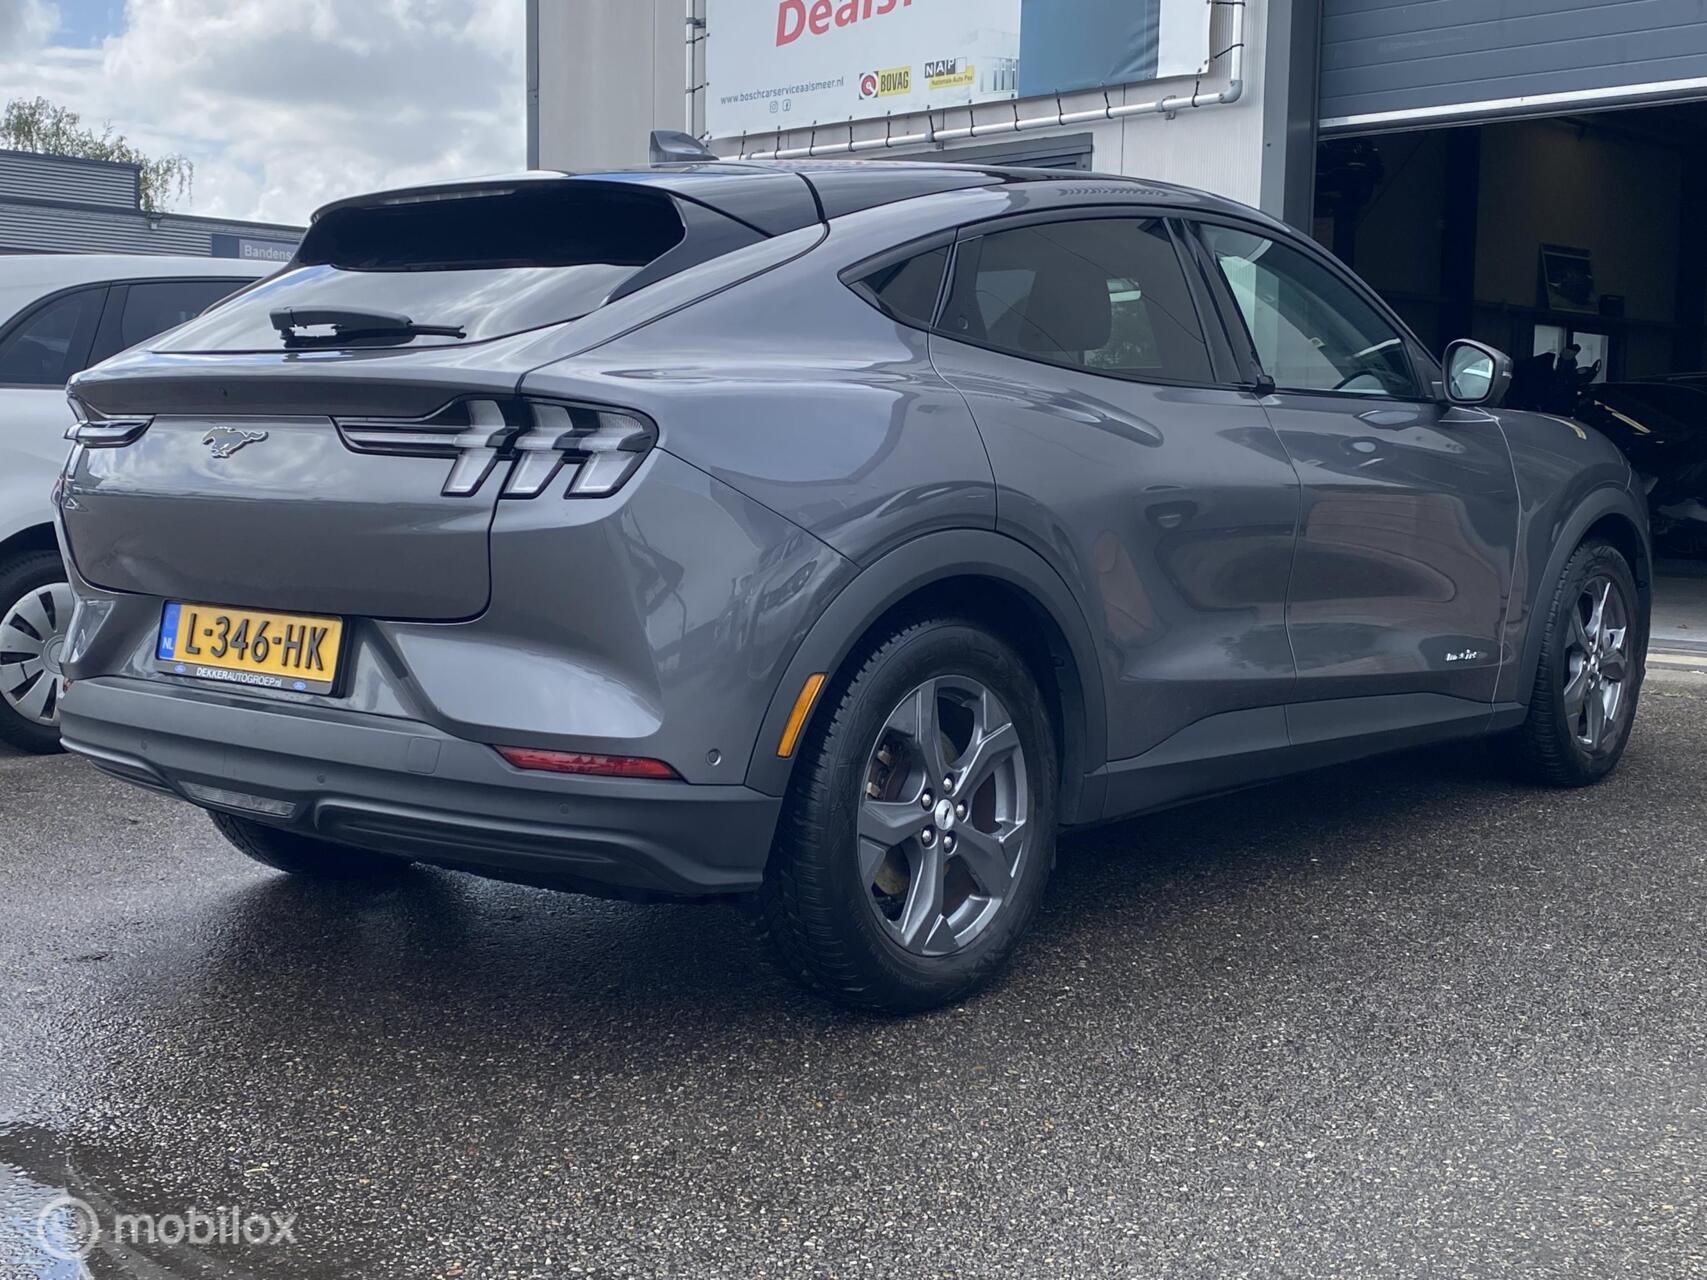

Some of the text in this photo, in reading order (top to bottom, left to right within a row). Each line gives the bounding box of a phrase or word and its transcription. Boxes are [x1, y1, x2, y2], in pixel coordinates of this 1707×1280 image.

[720, 77, 844, 104] www.boschcarserviceaalsmeer.nl
[880, 71, 909, 92] BOVAG
[244, 244, 295, 260] Bandens
[162, 637, 174, 650] NL
[185, 613, 328, 671] L-346-HK
[196, 667, 282, 687] DEKKERAUTOGROEP.nl
